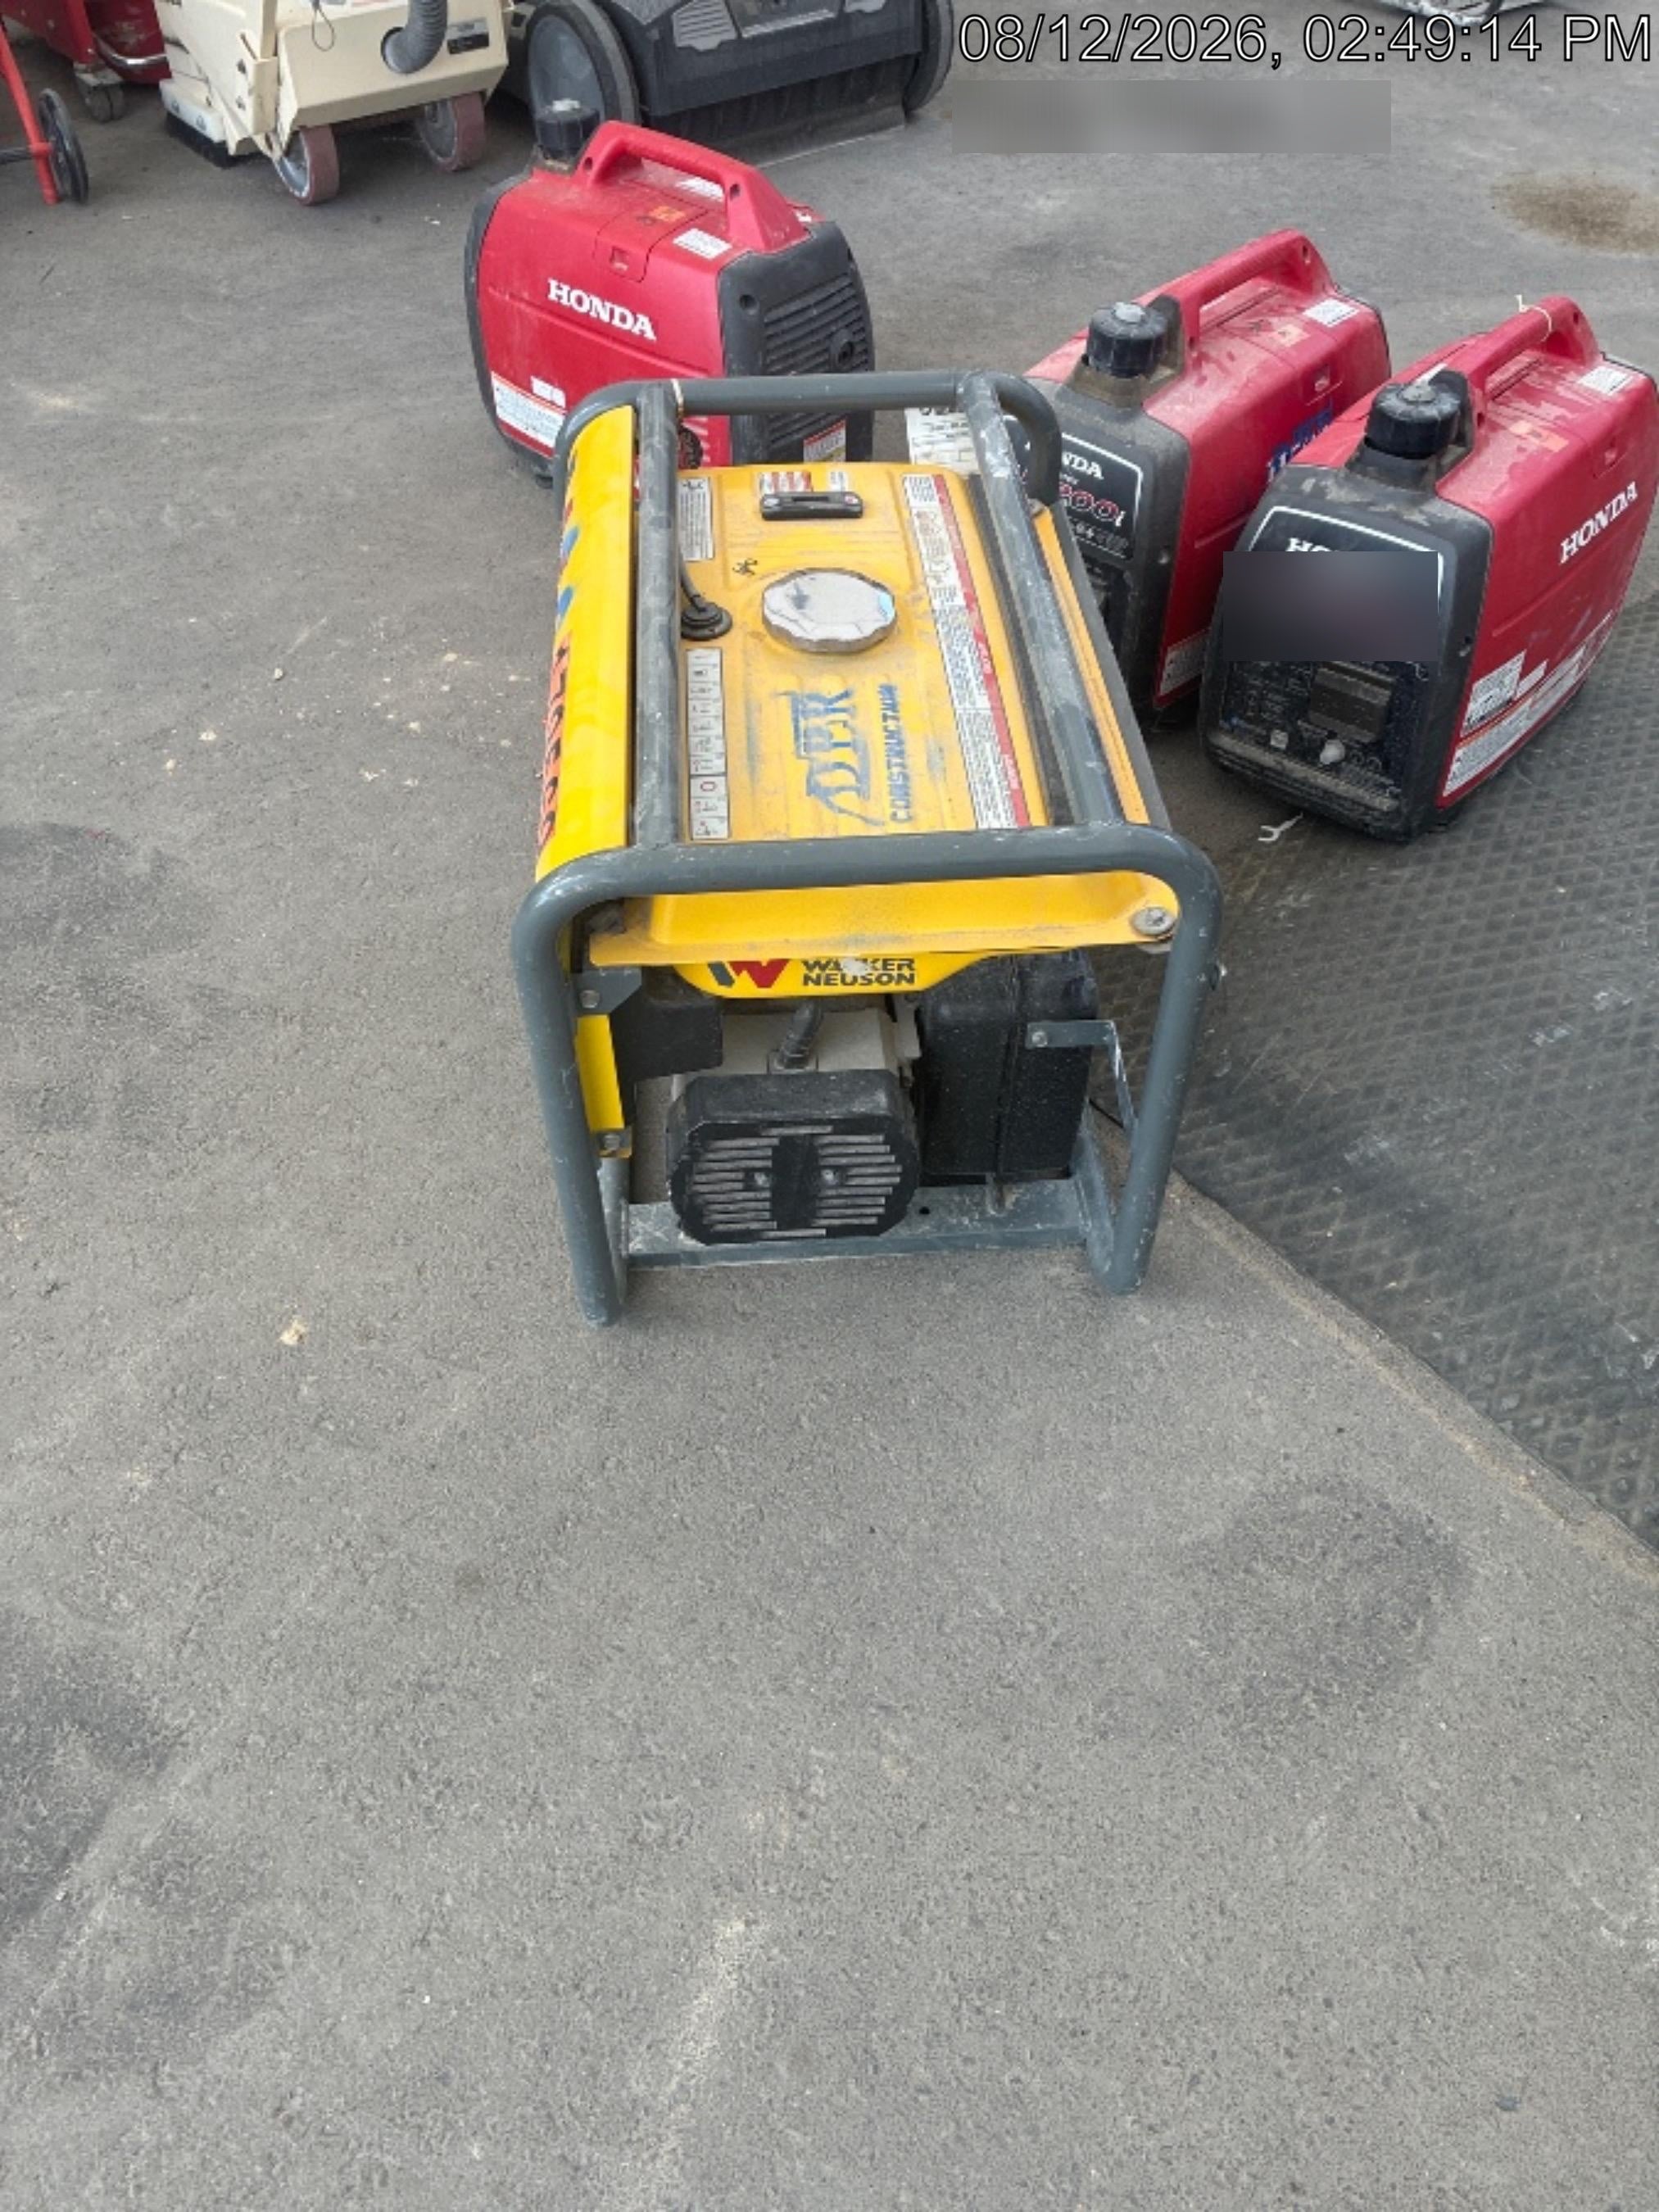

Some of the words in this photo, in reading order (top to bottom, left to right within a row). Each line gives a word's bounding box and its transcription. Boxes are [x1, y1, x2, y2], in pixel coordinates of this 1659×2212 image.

[547, 277, 657, 342] HONDA
[1061, 451, 1104, 480] NDA
[1557, 479, 1639, 565] HONDA
[802, 972, 915, 986] NEUSON
